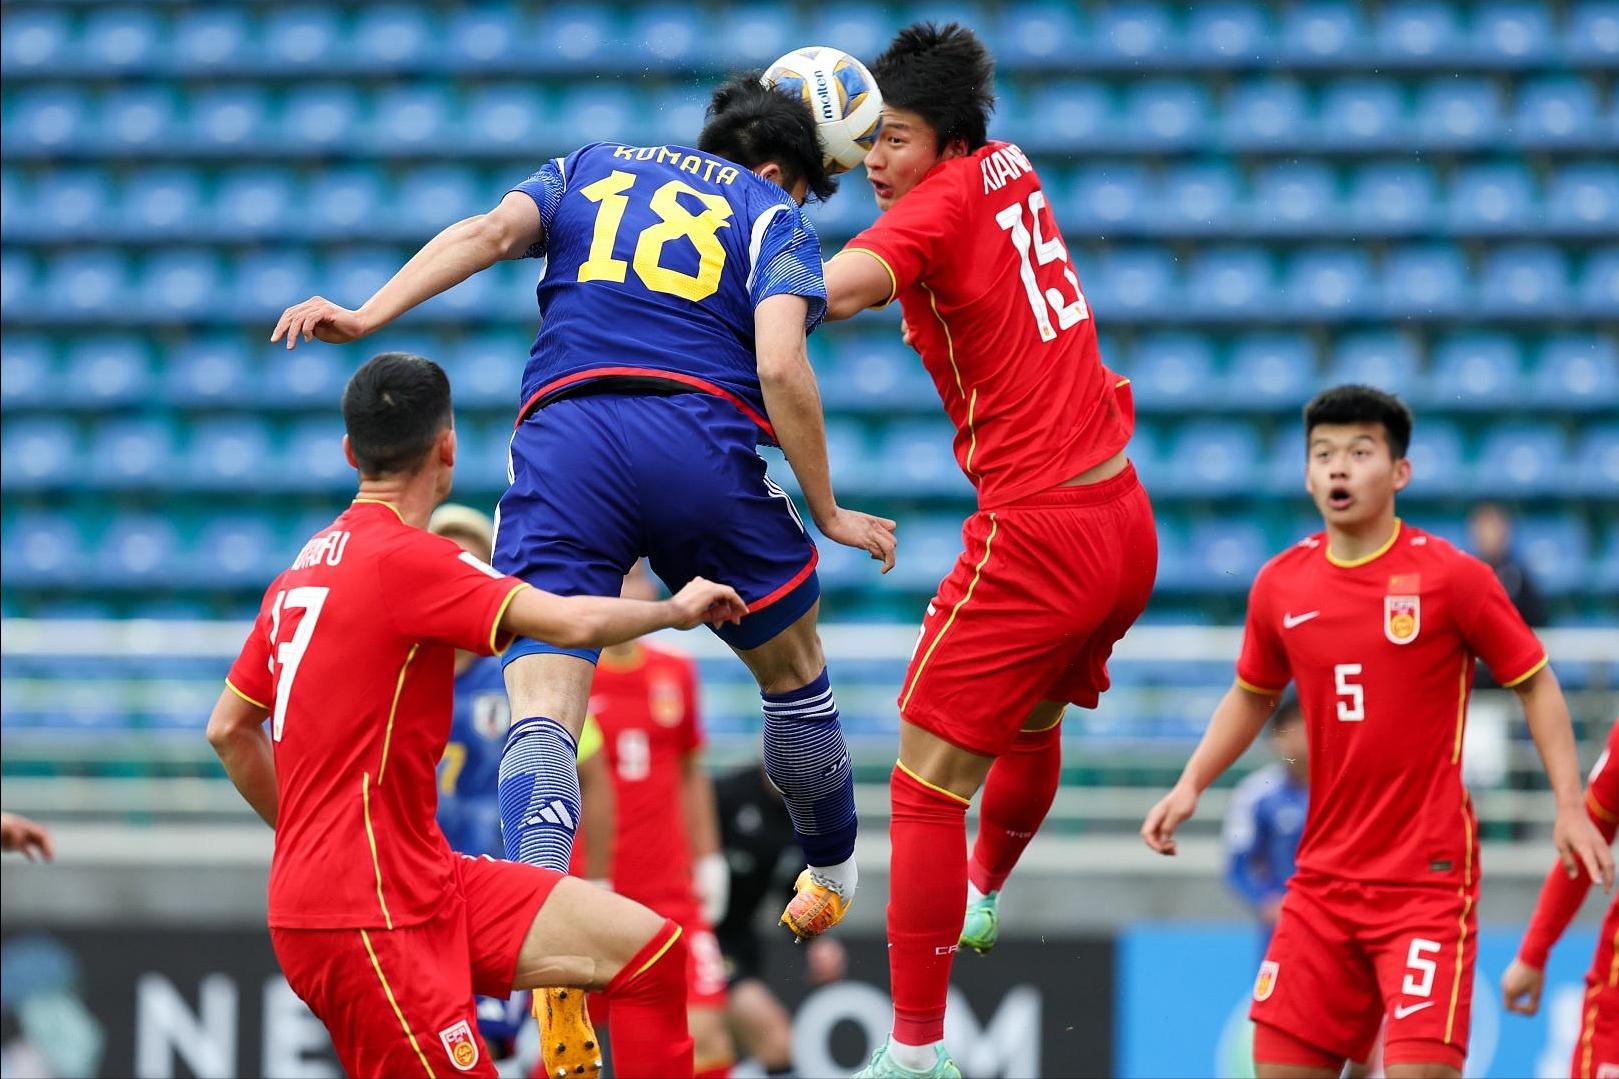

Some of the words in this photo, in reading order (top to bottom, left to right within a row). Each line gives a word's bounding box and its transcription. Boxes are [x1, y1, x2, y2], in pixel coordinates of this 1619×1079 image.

[814, 70, 833, 119] molten
[577, 169, 734, 302] 18
[995, 190, 1090, 343] 15
[1334, 663, 1366, 722] 5
[1401, 937, 1442, 998] 5
